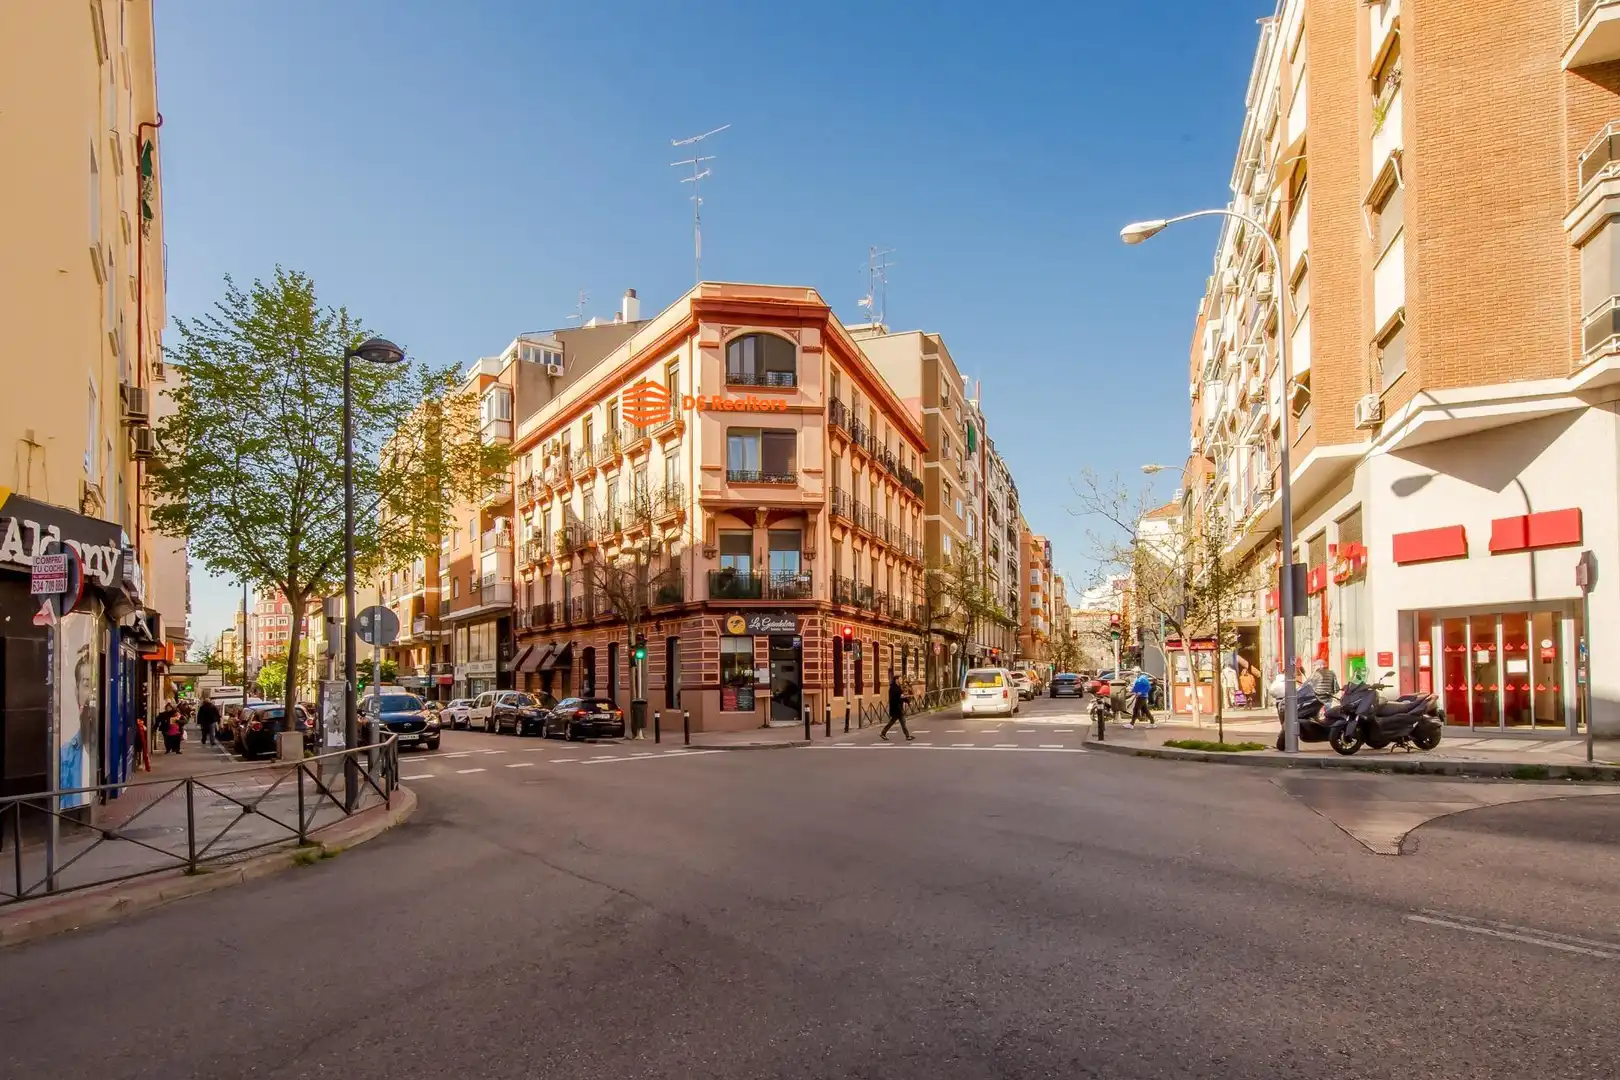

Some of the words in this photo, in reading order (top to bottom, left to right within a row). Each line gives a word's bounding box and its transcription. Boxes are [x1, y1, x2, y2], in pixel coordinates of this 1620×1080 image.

[35, 556, 63, 565] COMPRO
[33, 565, 43, 573] TU
[44, 564, 64, 573] COCHE
[33, 580, 44, 592] 634
[748, 616, 761, 630] La
